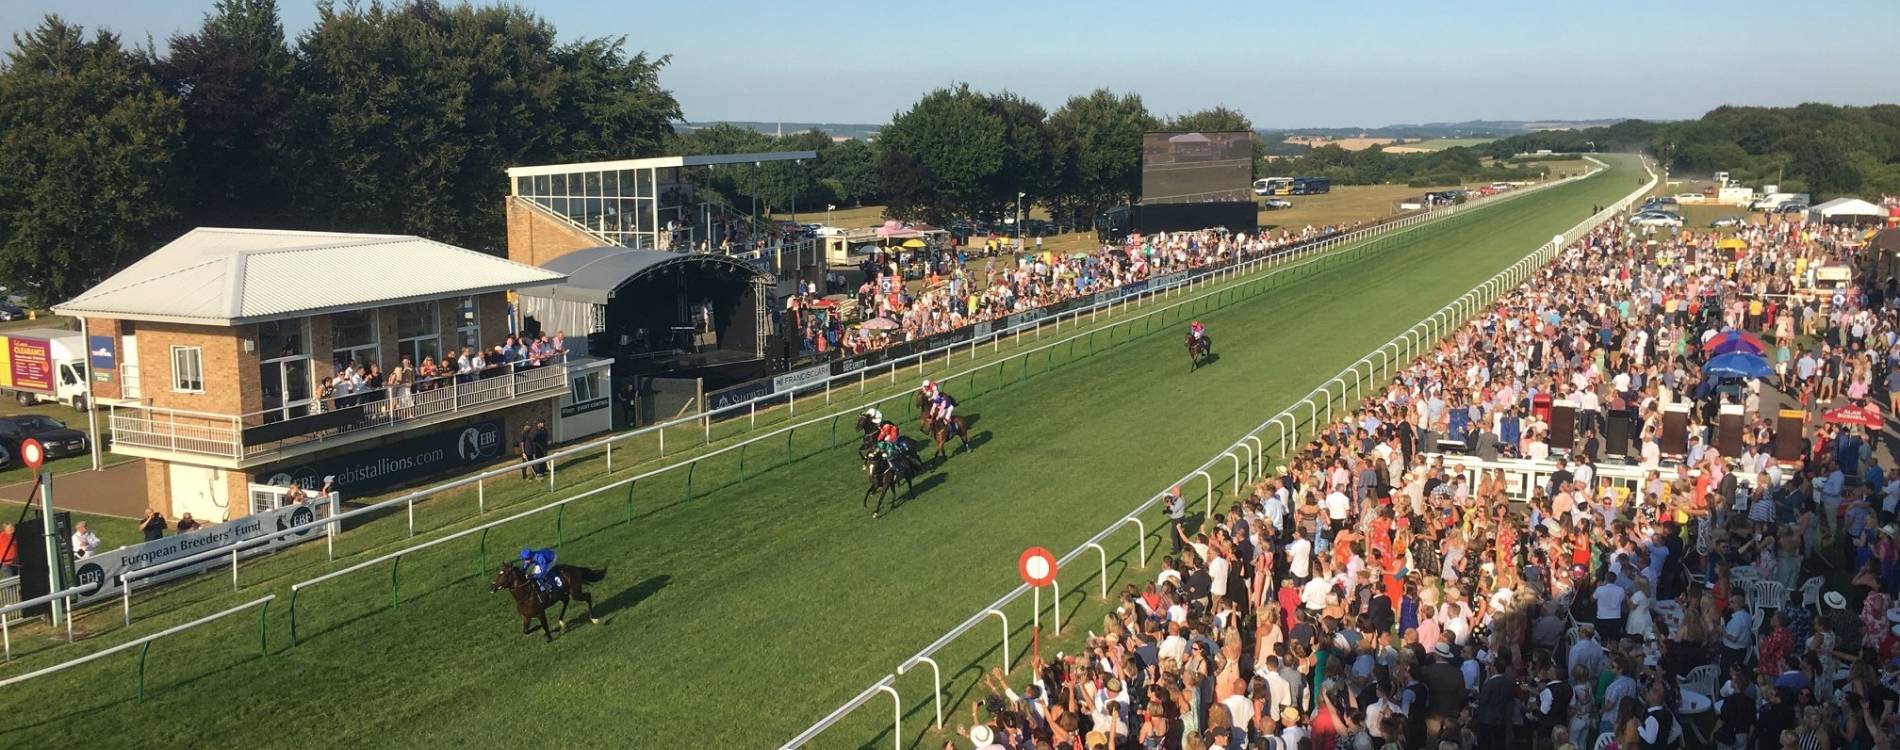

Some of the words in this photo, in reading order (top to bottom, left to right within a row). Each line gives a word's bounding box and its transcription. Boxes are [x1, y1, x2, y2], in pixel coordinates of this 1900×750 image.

[480, 430, 497, 446] EBF
[338, 447, 444, 486] ebfstallions.com
[293, 510, 312, 526] EBF
[121, 542, 177, 567] European
[180, 528, 232, 551] Breeders'
[235, 522, 261, 538] Fund
[79, 569, 102, 585] EBF
[554, 576, 563, 587] 3
